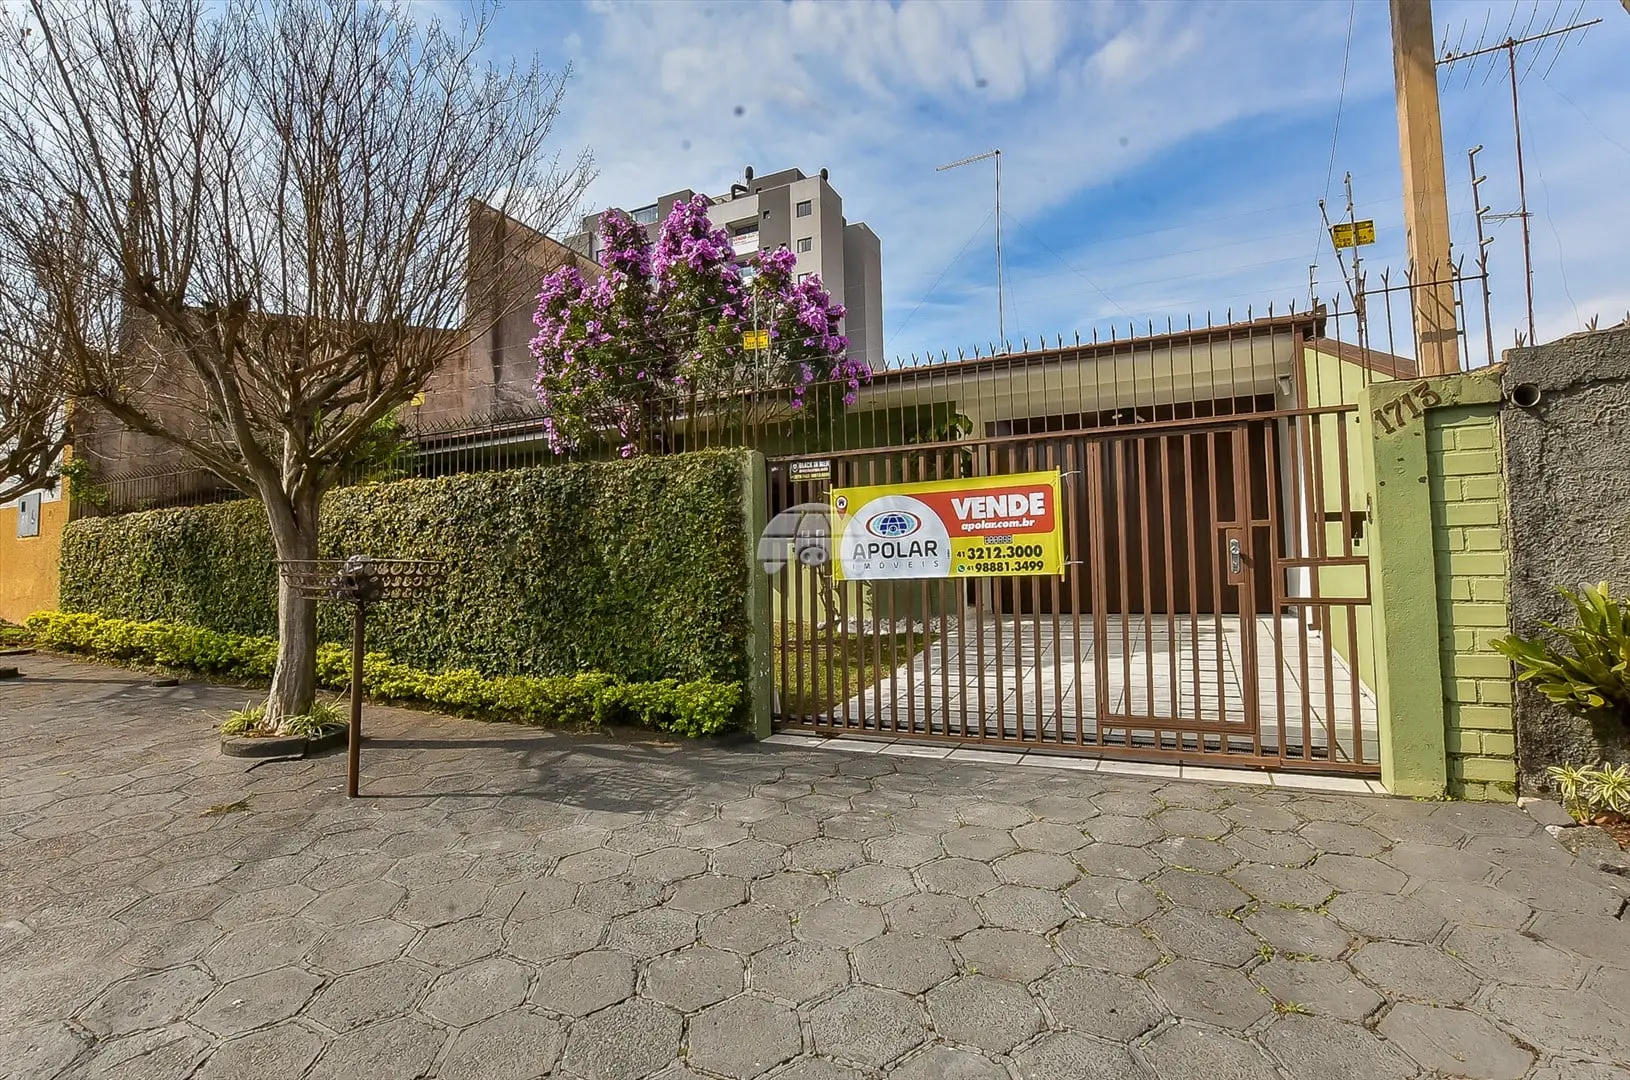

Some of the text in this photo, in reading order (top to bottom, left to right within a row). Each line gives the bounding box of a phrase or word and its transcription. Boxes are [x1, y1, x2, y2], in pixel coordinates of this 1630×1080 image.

[1373, 381, 1442, 434] 1713
[951, 492, 1045, 520] VENDE
[961, 518, 1035, 531] apolar.com.br
[853, 540, 938, 559] APOLAR
[967, 545, 1042, 560] 3212.3000
[975, 561, 1044, 572] 98881.3499
